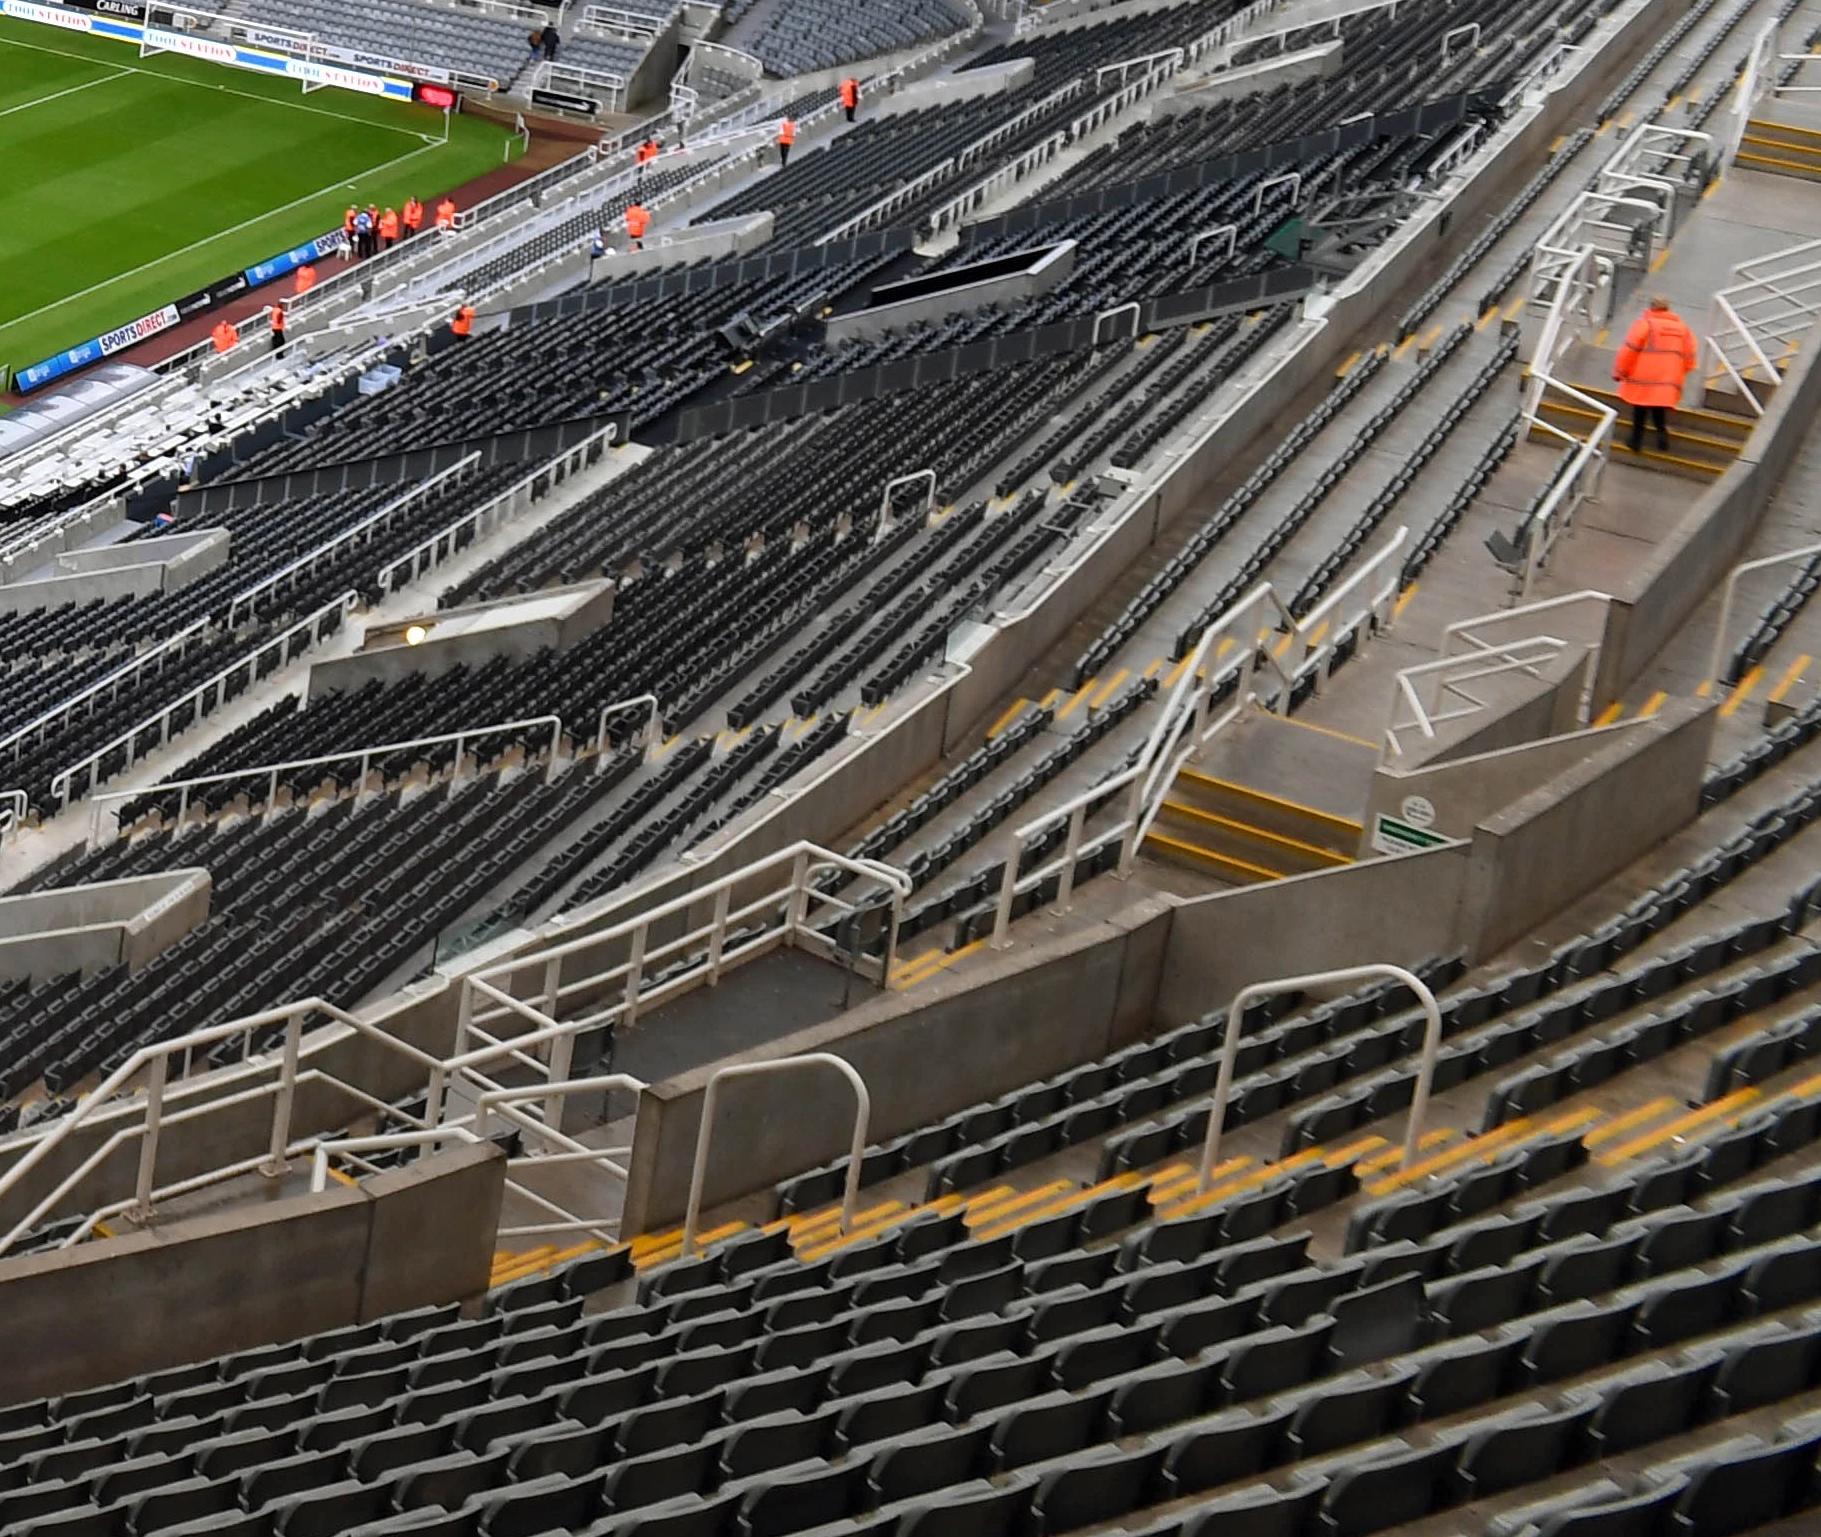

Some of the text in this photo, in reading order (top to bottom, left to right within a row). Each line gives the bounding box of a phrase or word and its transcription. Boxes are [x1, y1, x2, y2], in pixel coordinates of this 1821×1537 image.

[10, 4, 87, 28] TOOLSTATION
[96, 0, 139, 16] CARLING
[148, 32, 234, 59] TOOLSTATION
